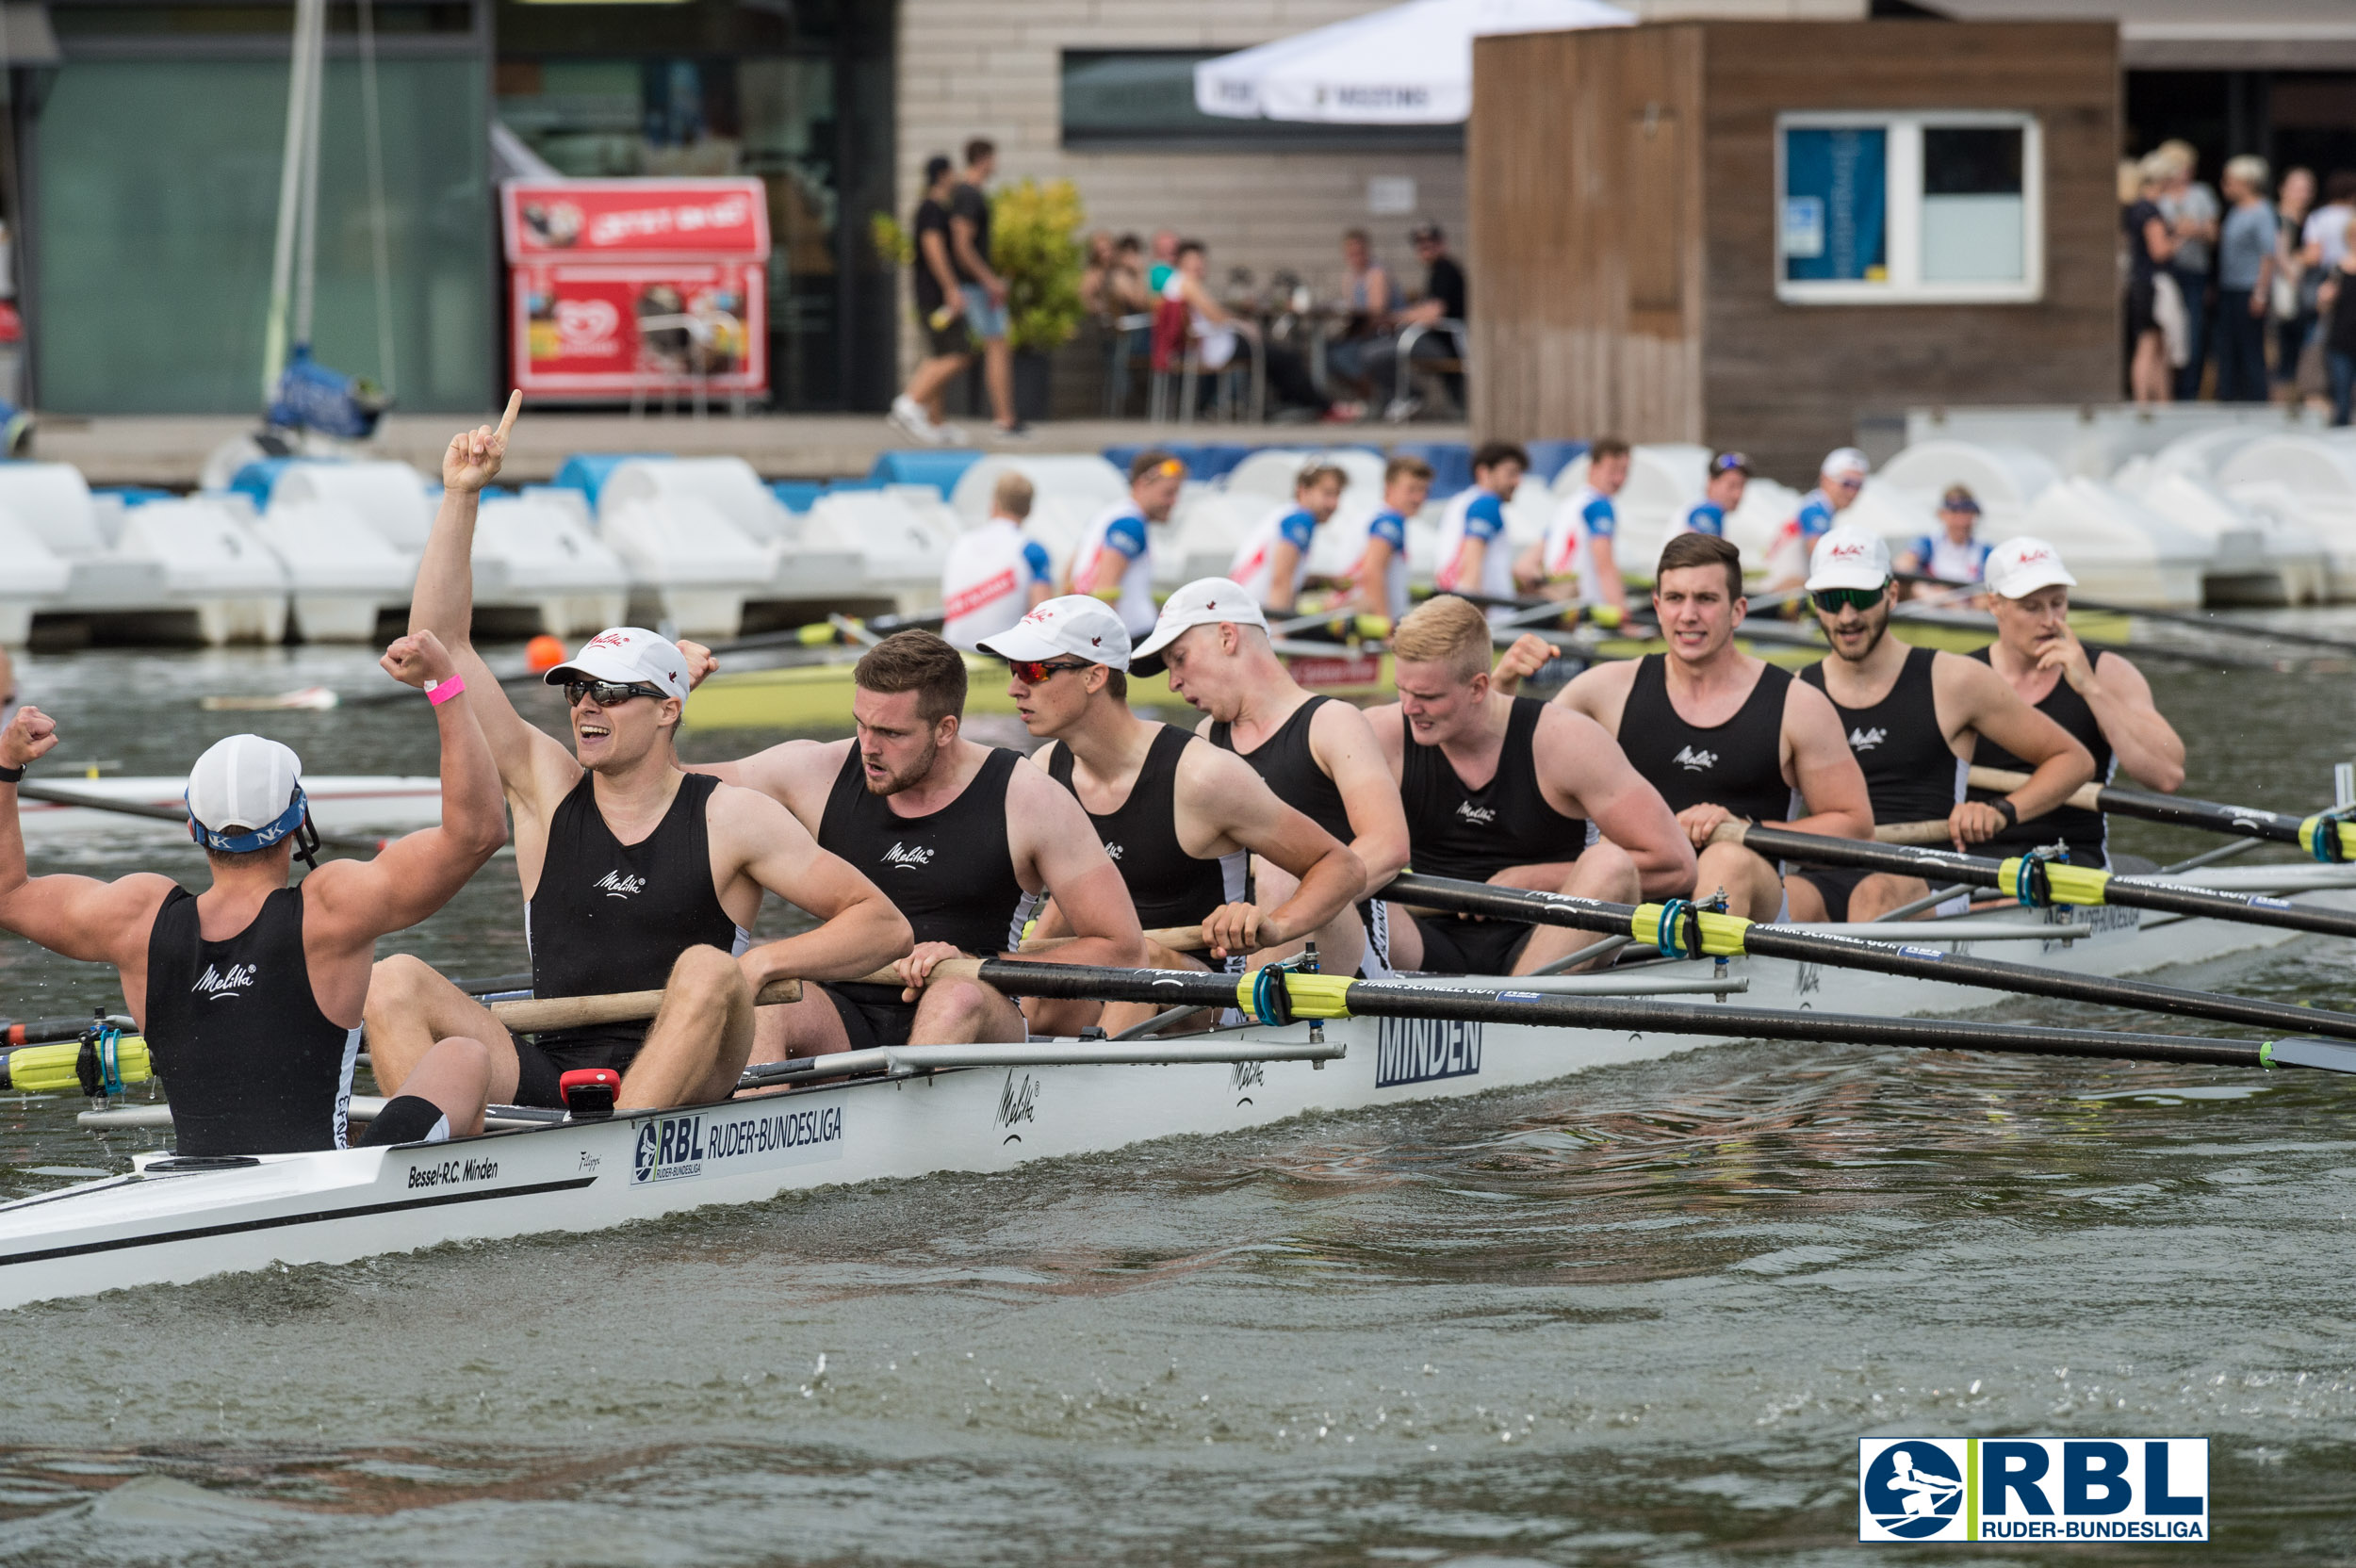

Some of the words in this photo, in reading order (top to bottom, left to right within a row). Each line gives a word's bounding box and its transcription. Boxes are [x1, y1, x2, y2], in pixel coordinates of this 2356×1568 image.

[255, 820, 286, 846] NK
[1378, 1017, 1481, 1084] MINDEN
[658, 1116, 704, 1166] RBL
[708, 1107, 843, 1160] RUDER-BUNDESLIGA
[408, 1161, 460, 1189] Bessel-R.C.
[462, 1156, 499, 1182] Minden
[656, 1163, 701, 1179] RUDER-BUNDESLIGA
